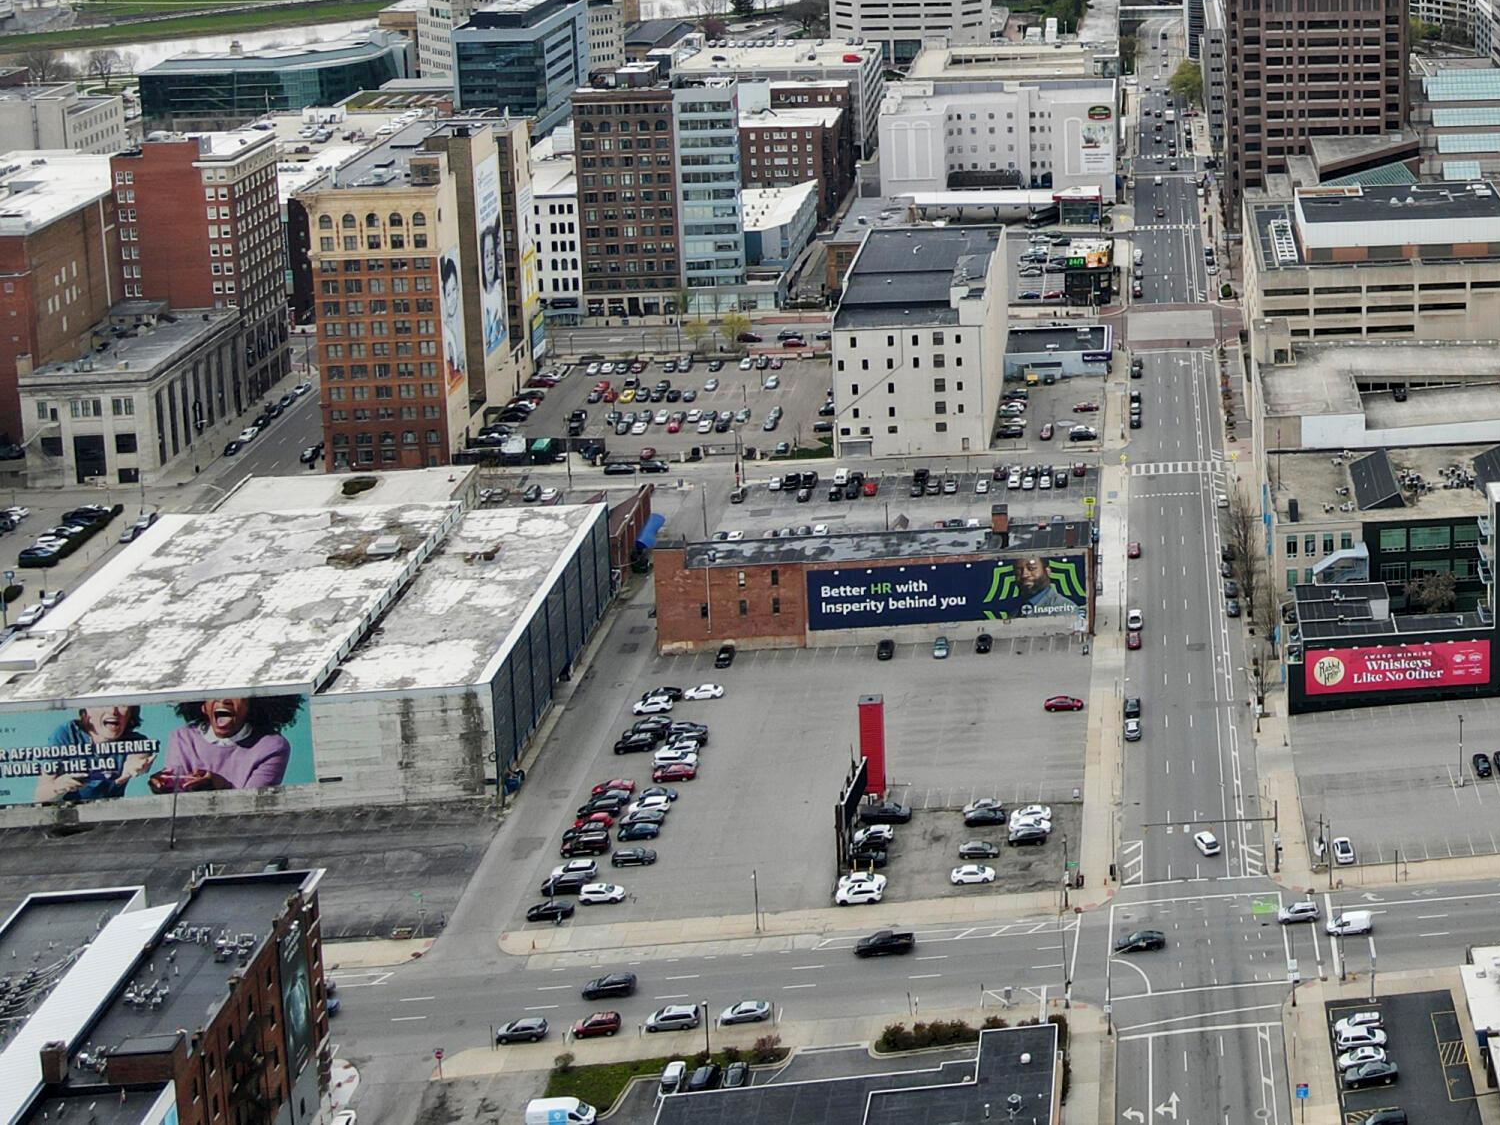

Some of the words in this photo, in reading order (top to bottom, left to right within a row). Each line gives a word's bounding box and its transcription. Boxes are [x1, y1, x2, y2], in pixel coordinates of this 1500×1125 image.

[821, 585, 867, 598] Better
[870, 583, 892, 594] HR
[895, 579, 928, 593] with
[821, 599, 885, 615] Insperity
[888, 595, 937, 609] behind
[940, 595, 967, 610] you
[1034, 603, 1075, 614] Insperity
[1366, 657, 1432, 672] Whiskeys
[1353, 672, 1383, 684] Like
[1385, 670, 1403, 682] No
[1406, 668, 1444, 681] Other
[10, 744, 92, 759] AFFORDABLE
[96, 739, 158, 754] INTERNET
[4, 762, 39, 775] NONE
[42, 761, 59, 774] OF
[62, 759, 88, 772] THE
[90, 757, 116, 771] LAG
